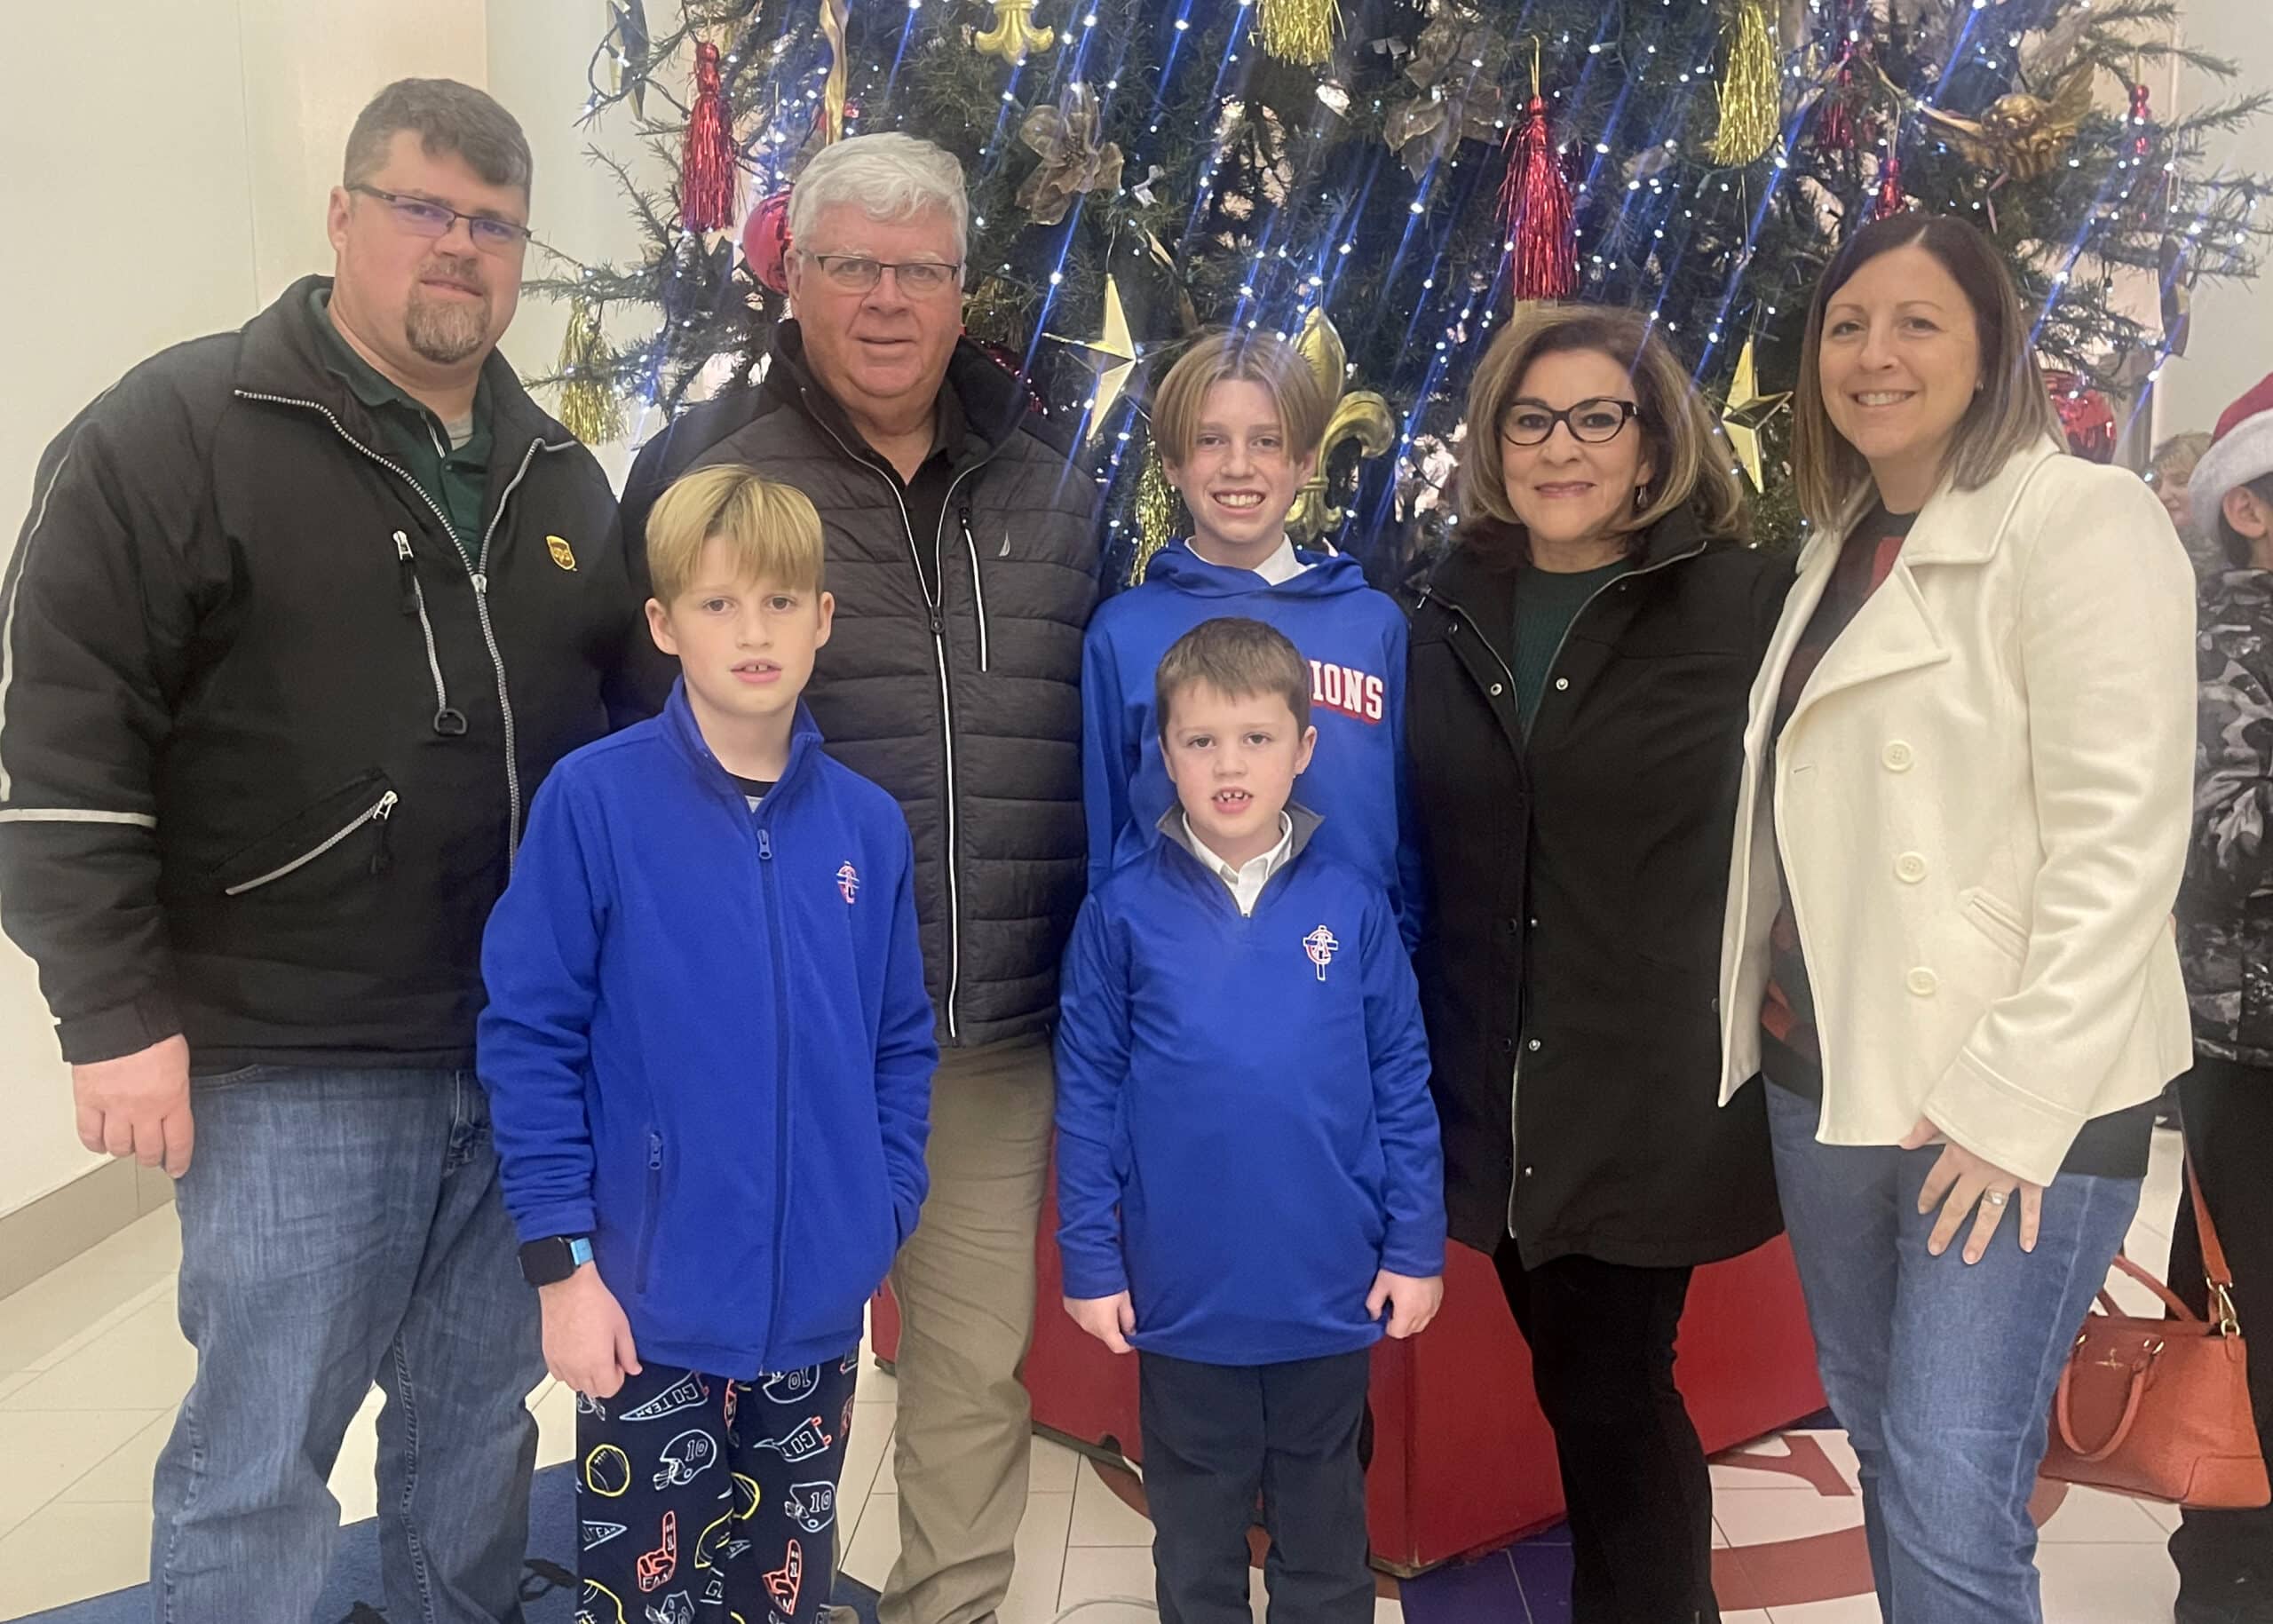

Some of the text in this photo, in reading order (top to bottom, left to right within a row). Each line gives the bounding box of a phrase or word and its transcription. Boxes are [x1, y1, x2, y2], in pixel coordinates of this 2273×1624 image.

[1310, 660, 1383, 720] IONS
[672, 1383, 699, 1404] GO
[685, 1439, 709, 1462] 10
[790, 1430, 816, 1454] GO
[810, 1490, 832, 1513] 10
